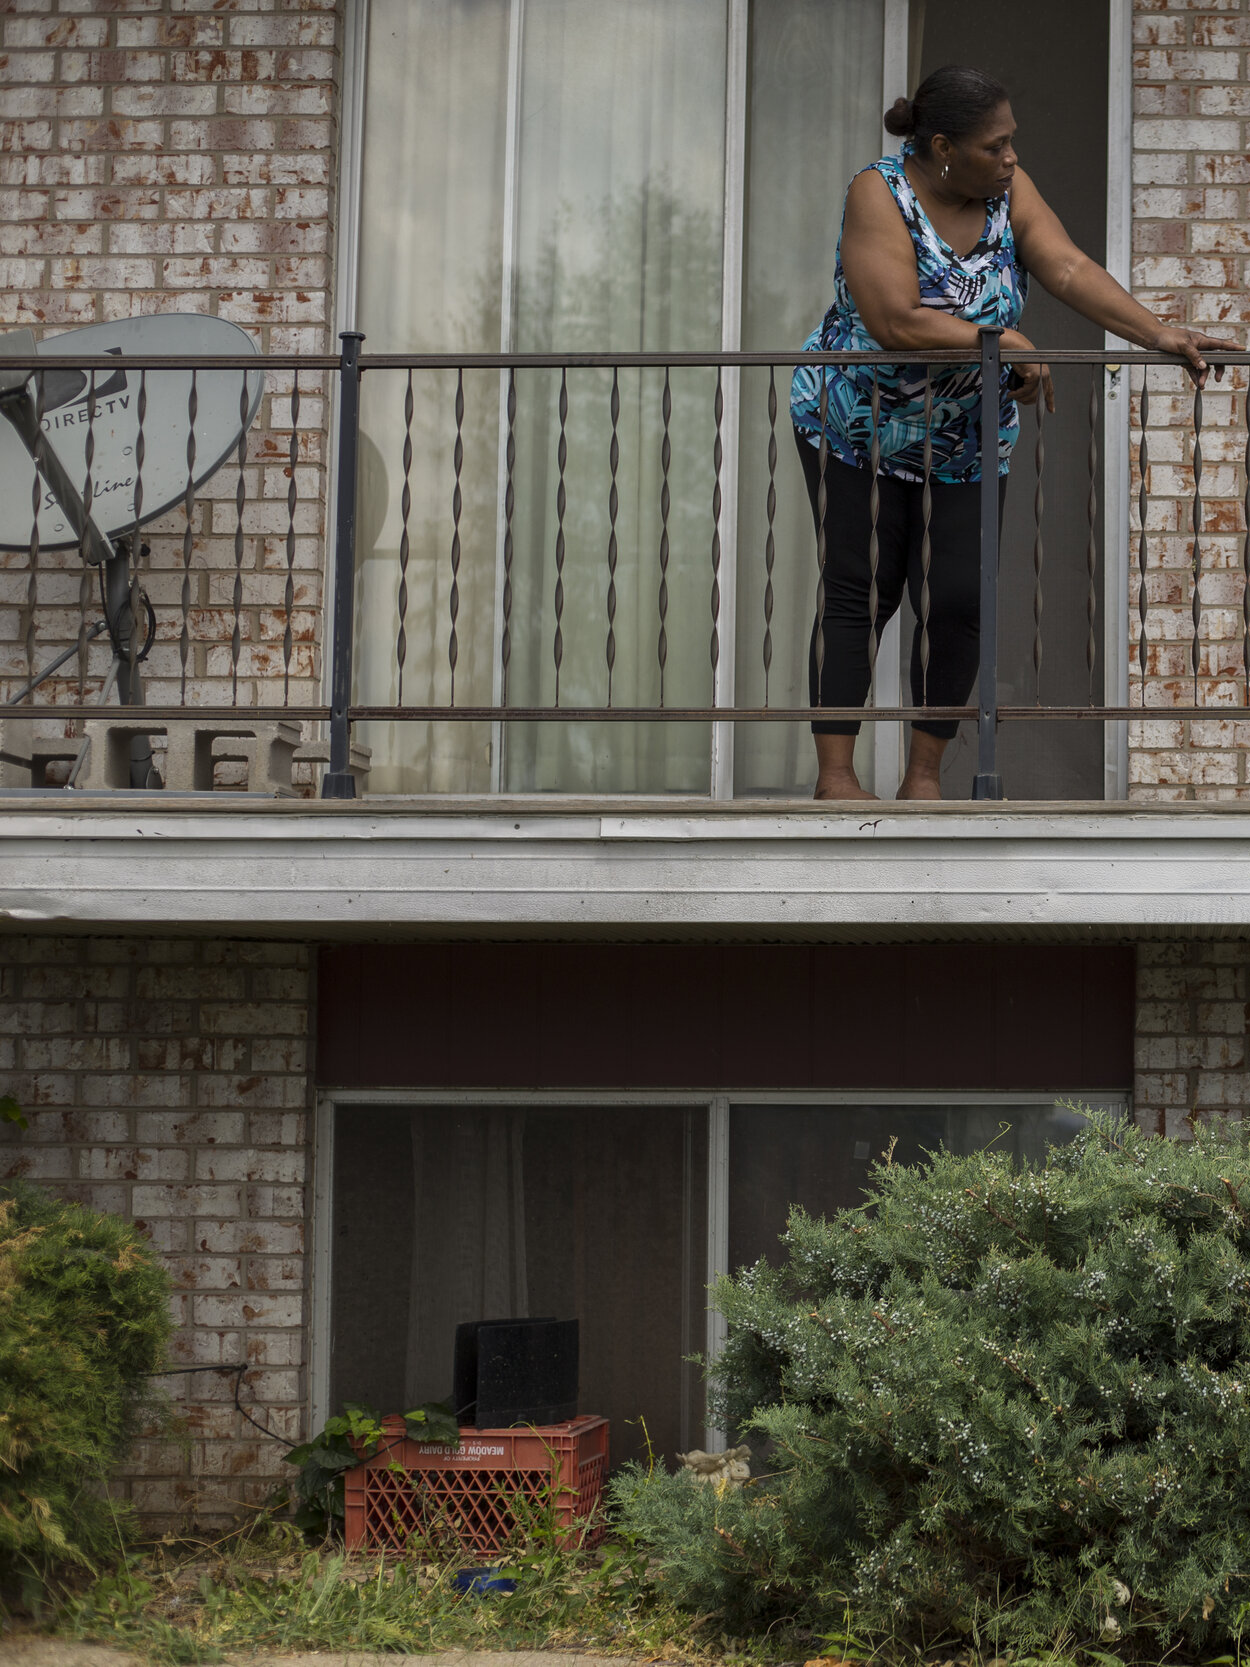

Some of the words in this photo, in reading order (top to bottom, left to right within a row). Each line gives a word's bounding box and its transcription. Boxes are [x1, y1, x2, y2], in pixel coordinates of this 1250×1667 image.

[40, 395, 129, 431] DIRECTV
[418, 1445, 443, 1455] DAIRY
[468, 1446, 504, 1455] MEADOW
